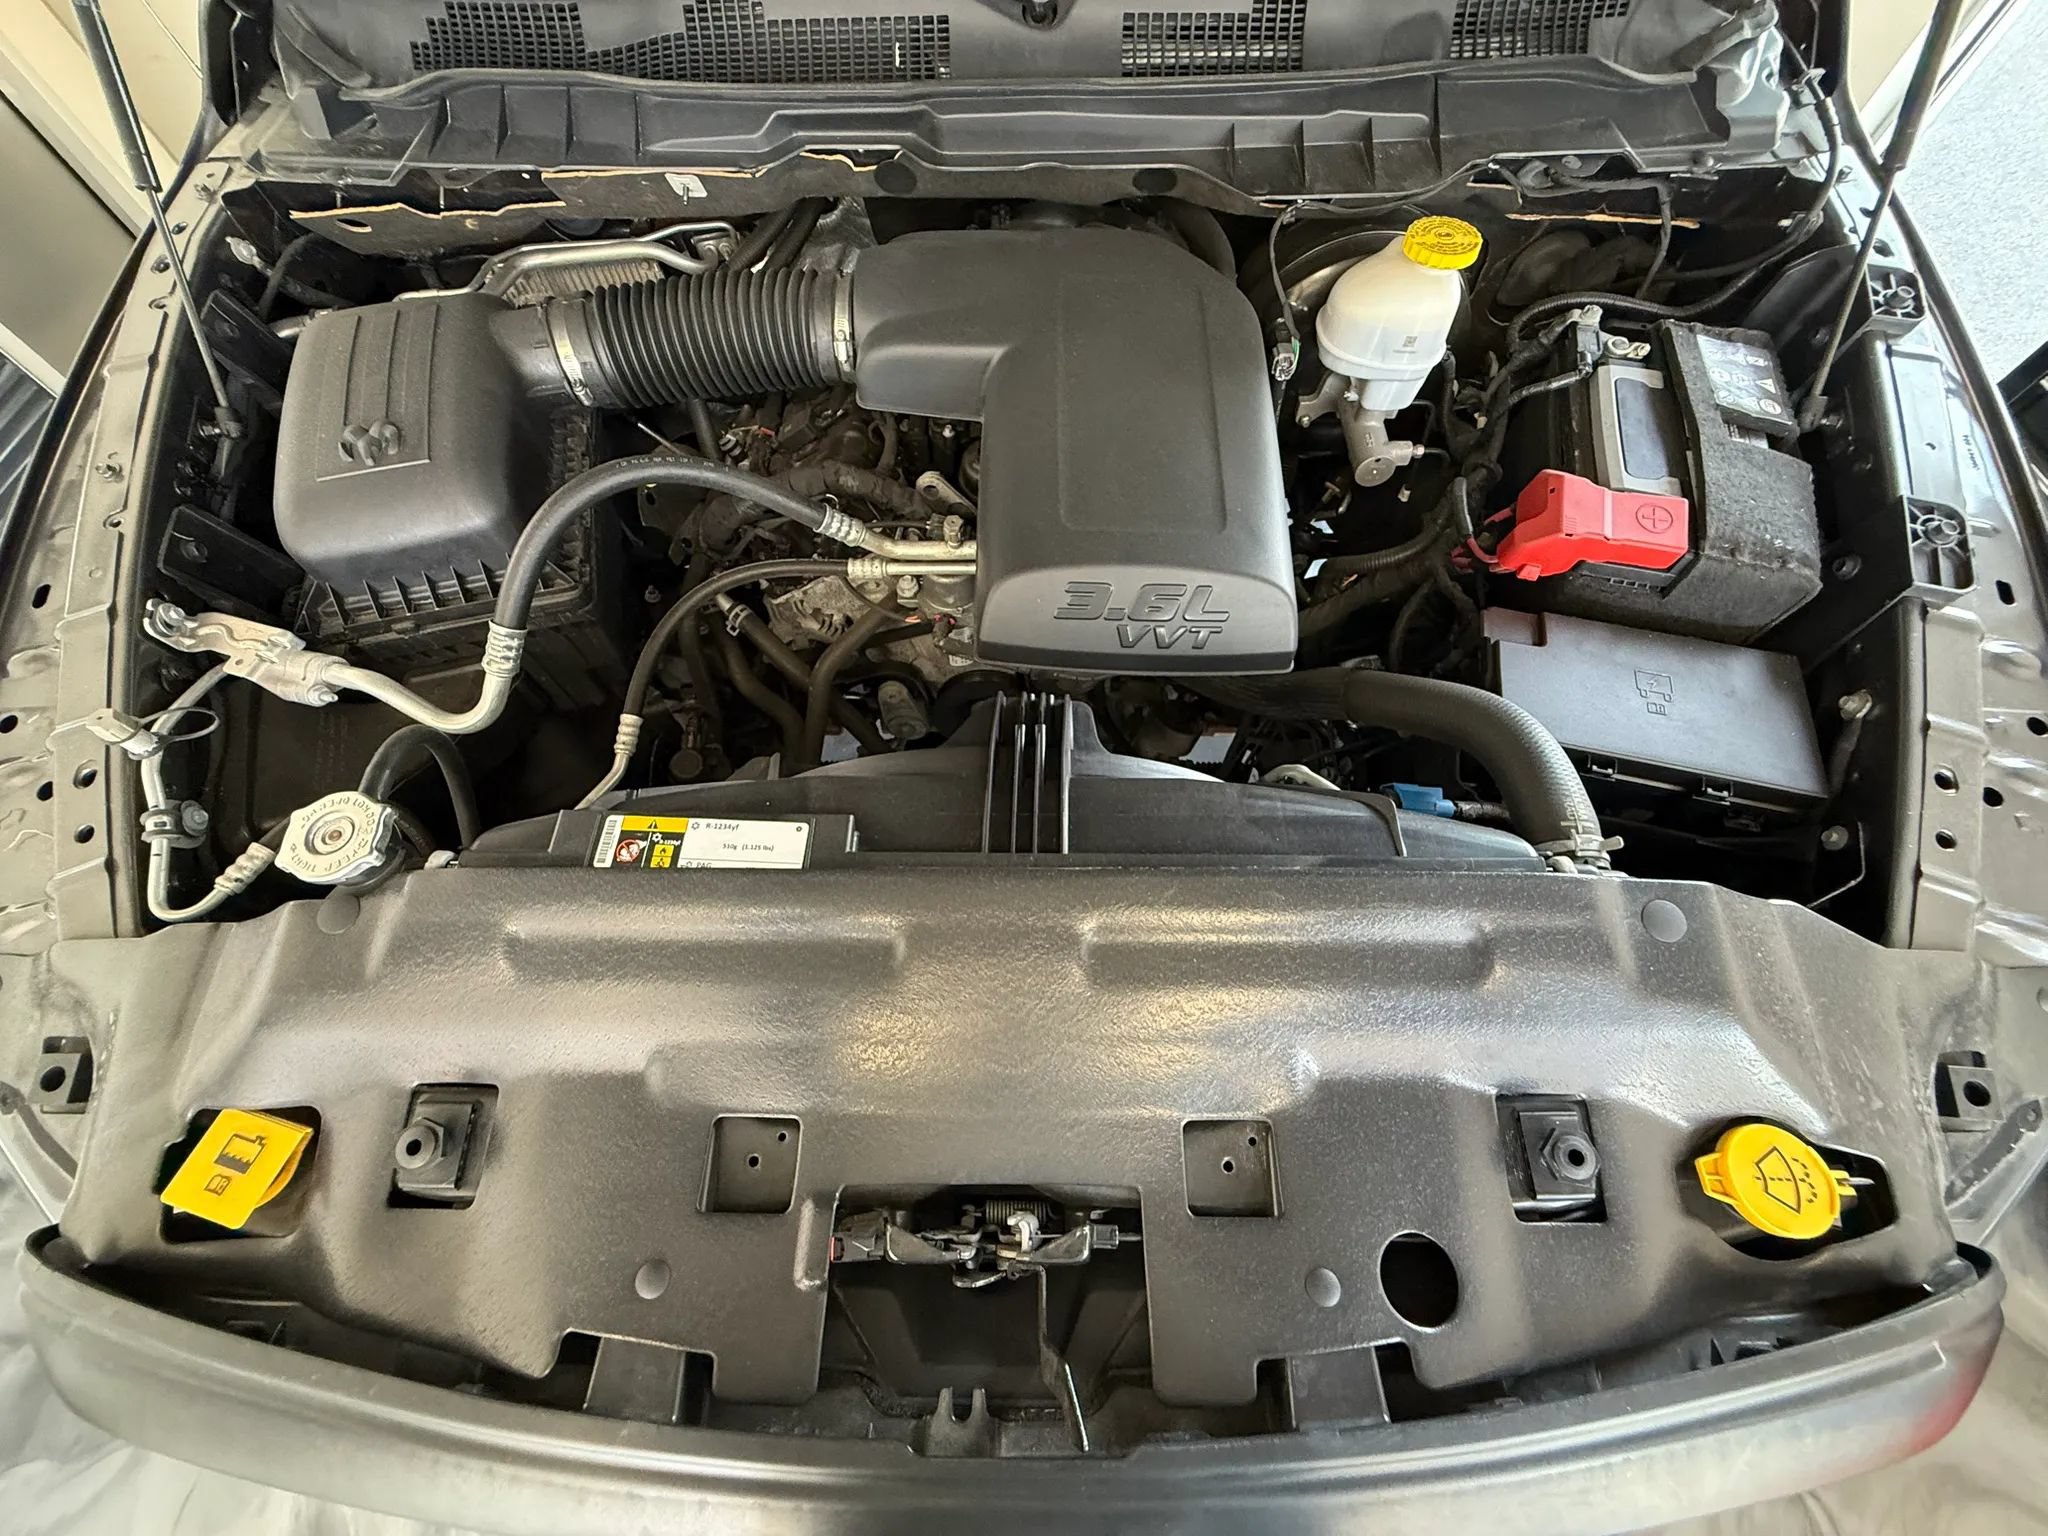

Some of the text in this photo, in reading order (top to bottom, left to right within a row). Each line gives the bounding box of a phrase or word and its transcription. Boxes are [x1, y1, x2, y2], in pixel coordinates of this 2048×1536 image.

[1053, 581, 1231, 622] 3.6L
[1117, 623, 1224, 650] VVT
[705, 822, 740, 832] R-1234yf
